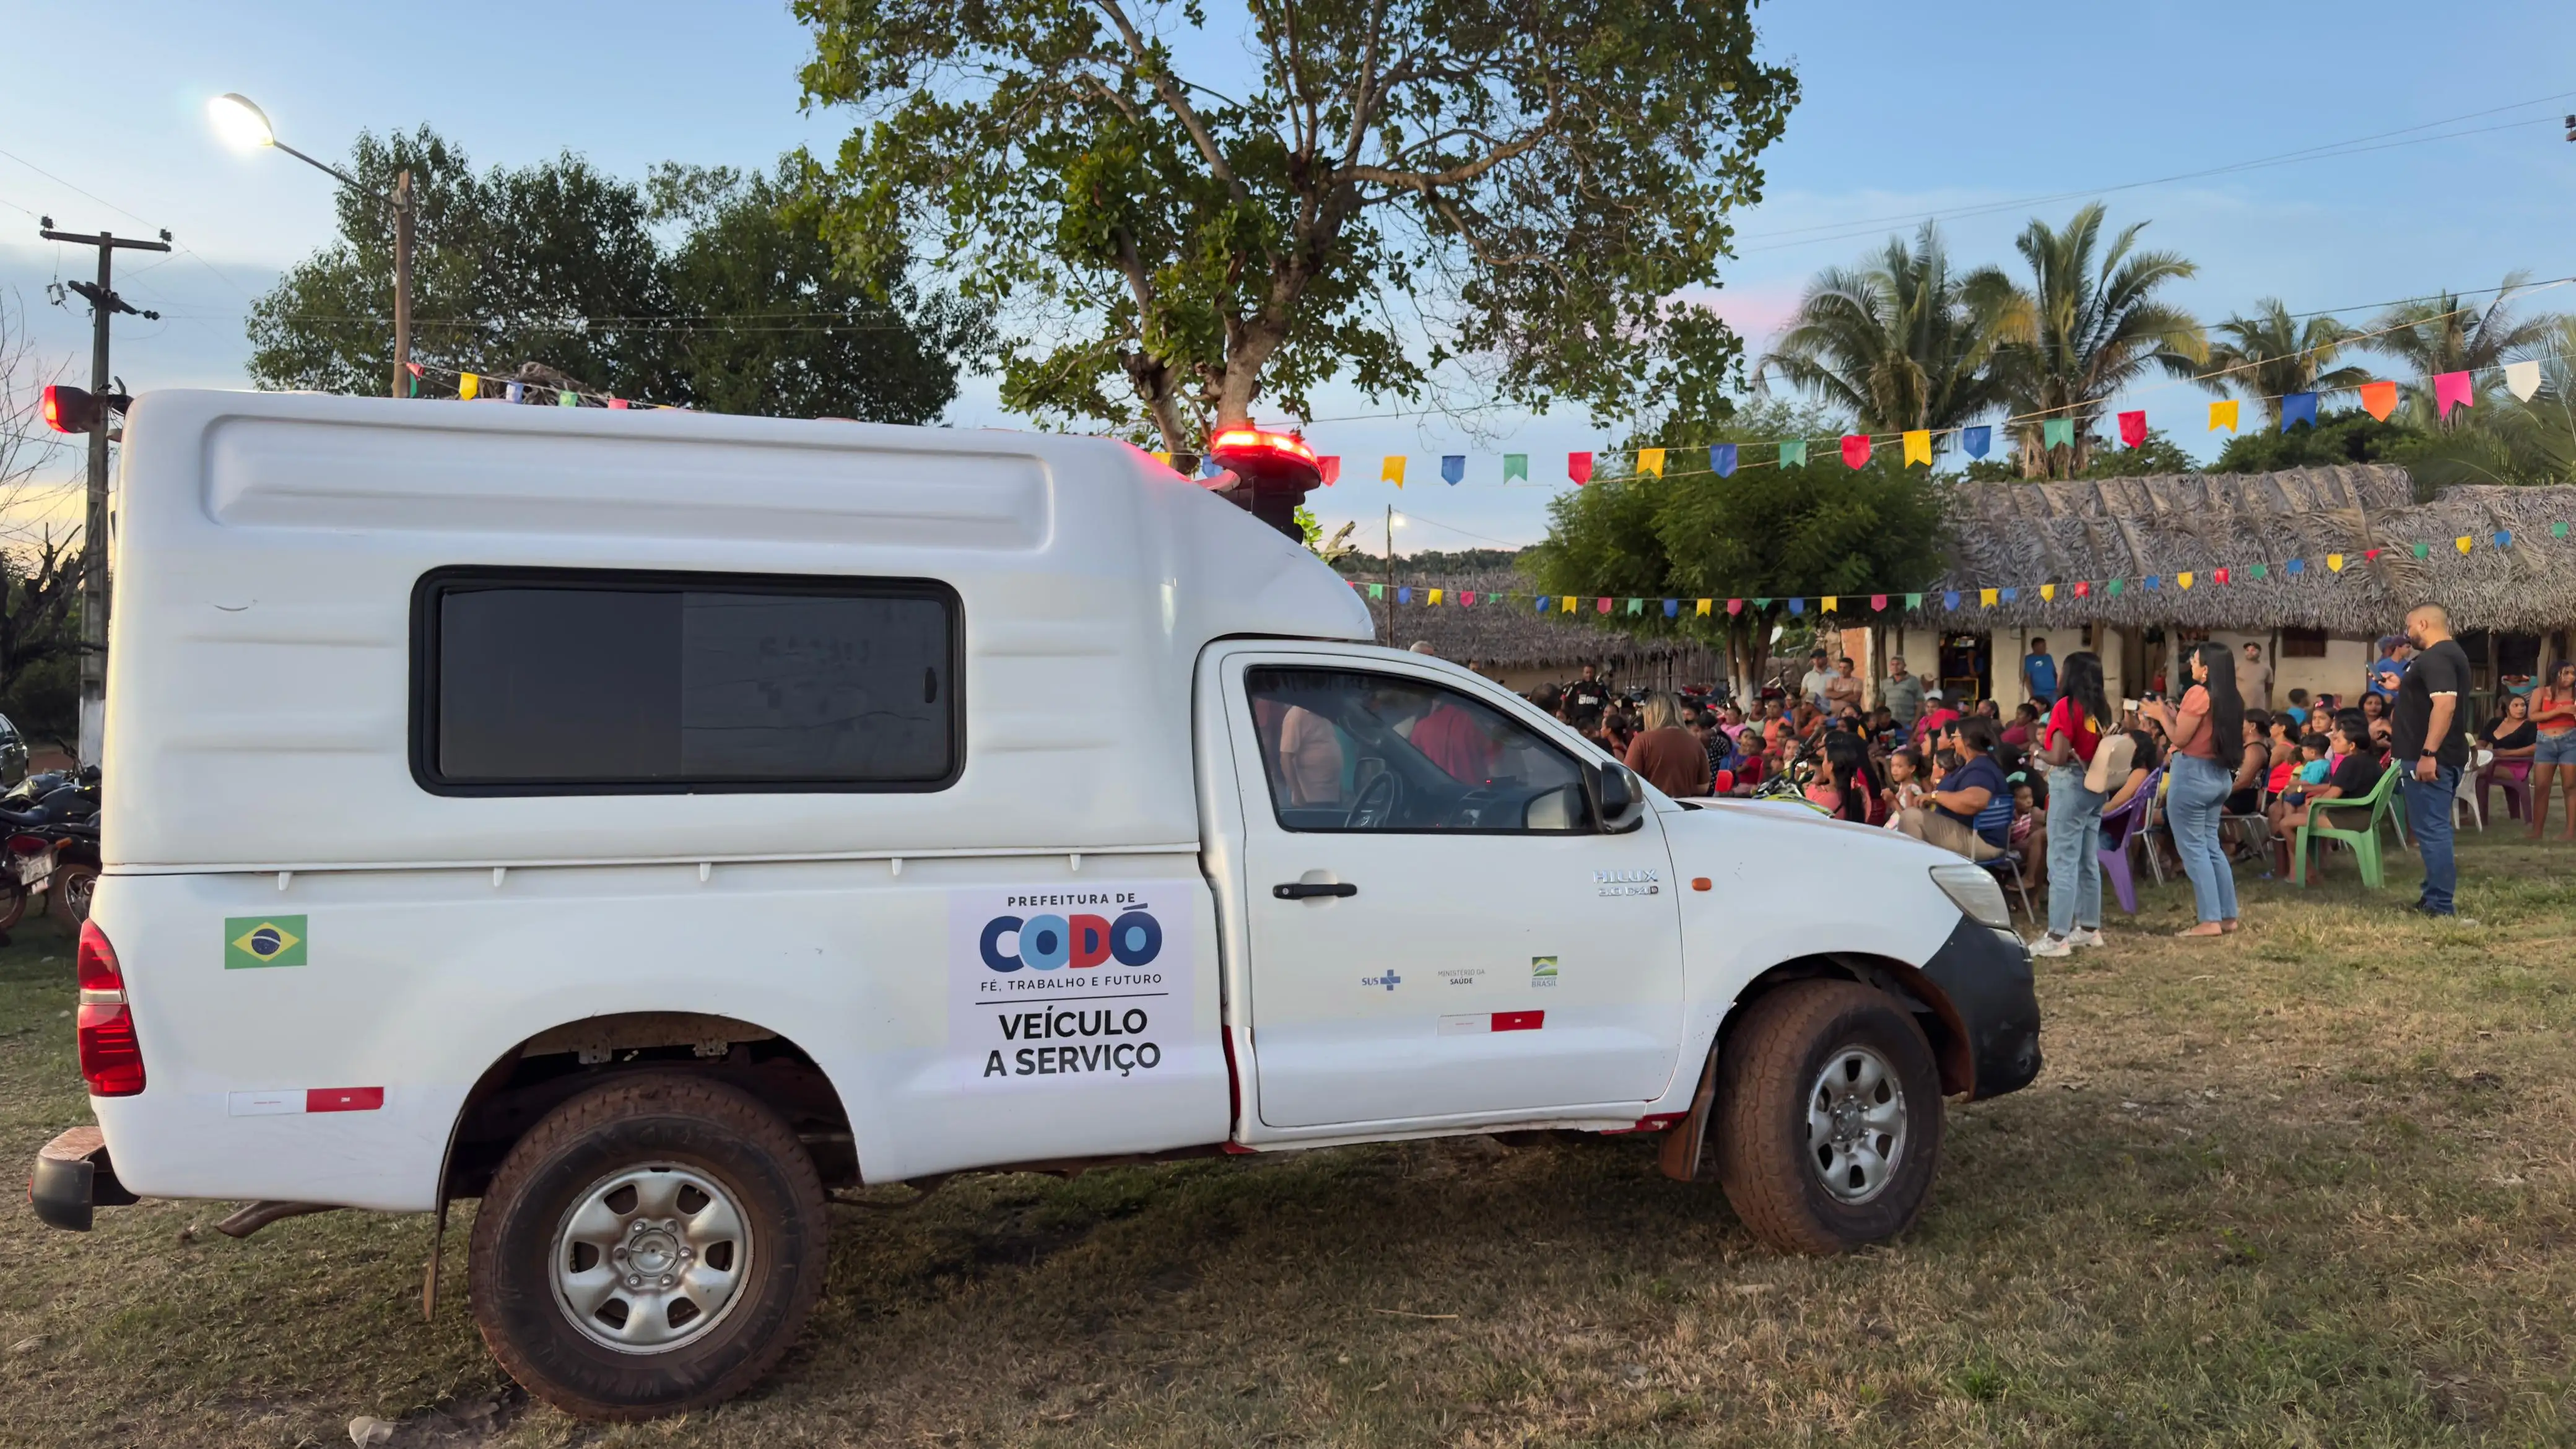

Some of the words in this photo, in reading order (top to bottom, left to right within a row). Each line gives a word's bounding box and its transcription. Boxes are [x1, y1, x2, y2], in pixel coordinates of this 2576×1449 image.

[1593, 869, 1658, 883] HILUX
[1007, 893, 1109, 907] PREFEITURA
[1116, 893, 1135, 903] DE
[980, 903, 1162, 973] CODÓ
[981, 978, 1002, 992] FÉ,
[1008, 977, 1086, 990] TRABALHO
[1092, 976, 1099, 986] E
[1105, 973, 1162, 986] FUTURO
[1362, 977, 1379, 986] SUS
[1450, 977, 1473, 985] SAÚDE
[1531, 979, 1556, 988] BRASIL
[998, 1005, 1148, 1040] VEÍCULO
[983, 1050, 1007, 1077] A
[1015, 1042, 1161, 1077] SERVIÇO
